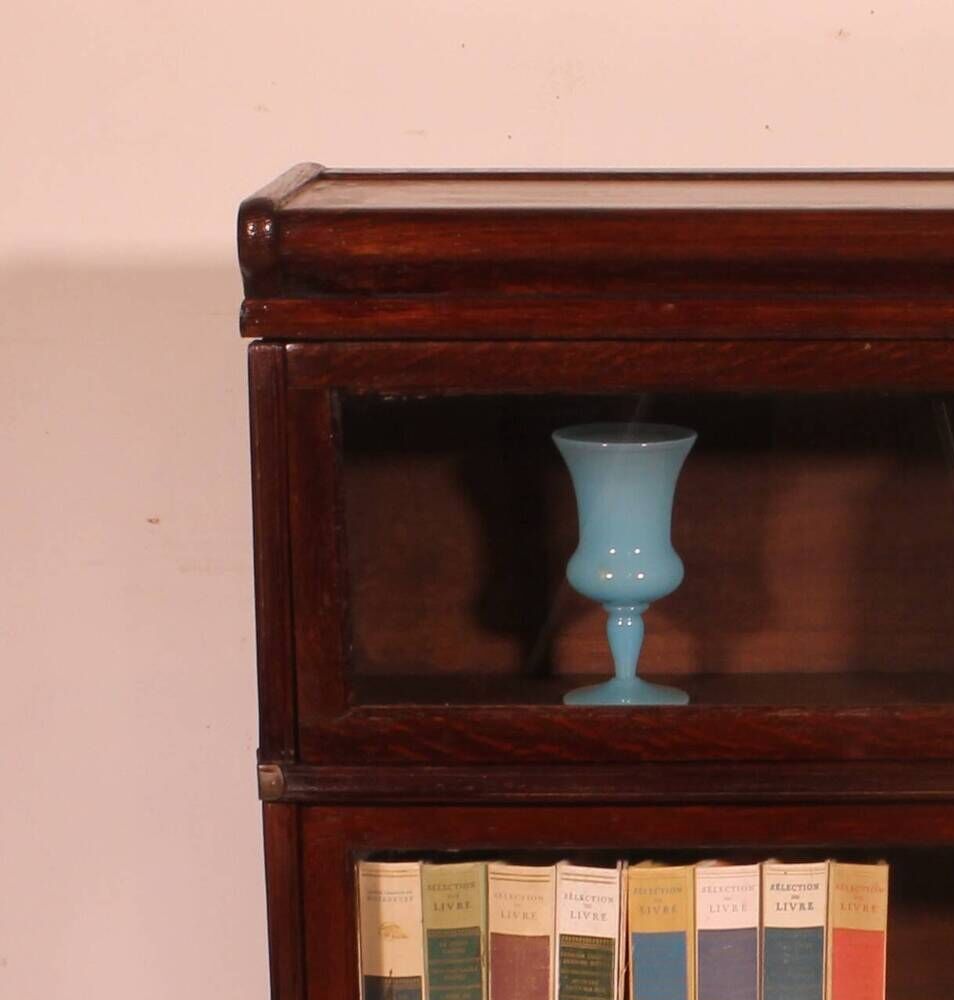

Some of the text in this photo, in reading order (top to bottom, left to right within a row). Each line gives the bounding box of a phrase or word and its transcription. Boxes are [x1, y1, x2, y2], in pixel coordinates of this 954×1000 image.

[433, 900, 472, 912] LIVRE
[639, 902, 678, 914] LIVRE
[709, 902, 747, 914] LIVRE
[775, 901, 815, 912] LIVRE
[839, 902, 880, 913] LIVRE
[500, 910, 538, 921] LIVRE
[570, 910, 609, 922] LIVRE
